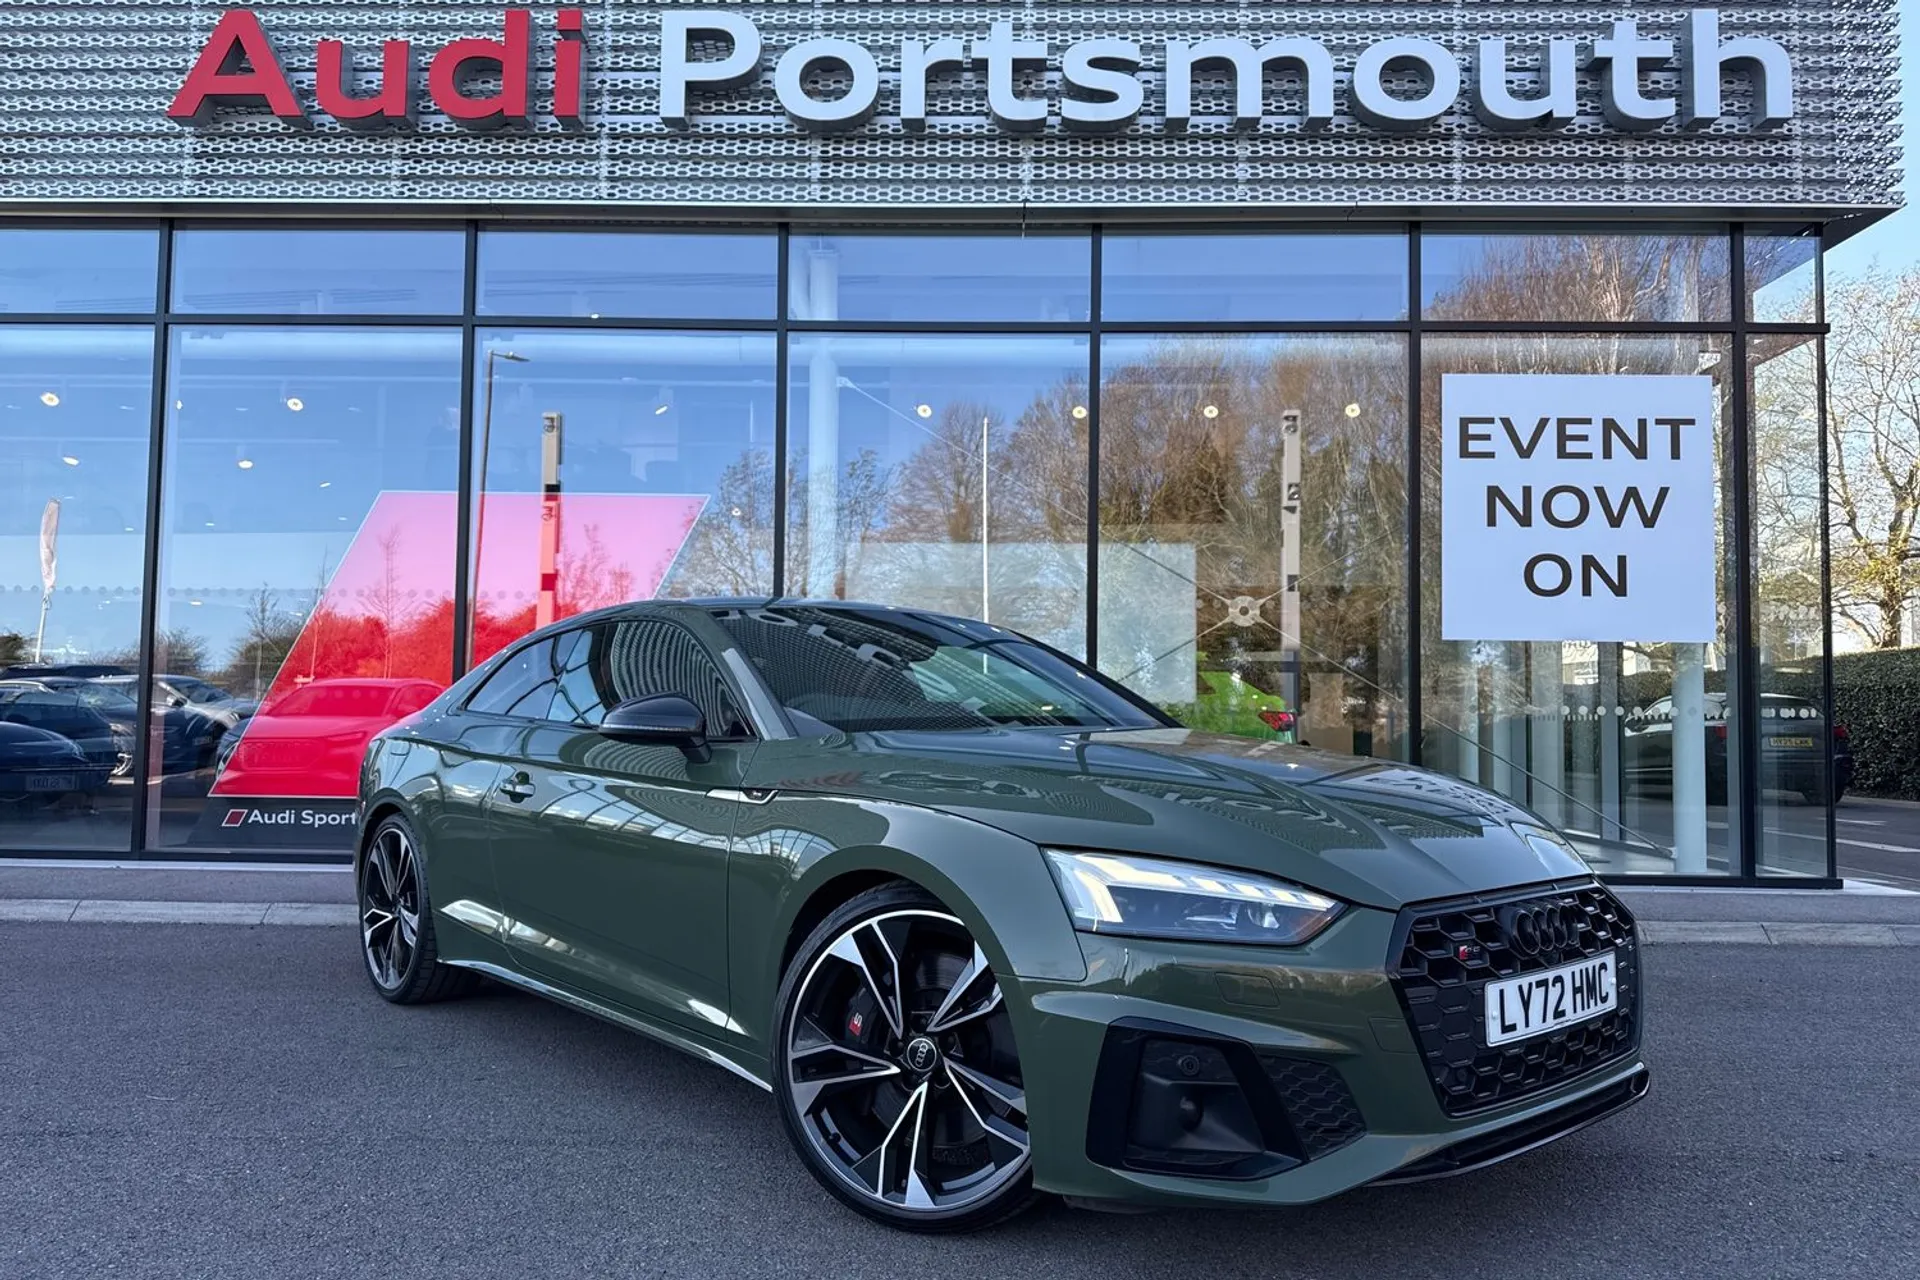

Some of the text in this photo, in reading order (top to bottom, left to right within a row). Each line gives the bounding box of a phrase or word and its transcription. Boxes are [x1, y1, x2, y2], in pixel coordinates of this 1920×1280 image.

[167, 8, 1794, 122] Audi Portsmouth
[1459, 417, 1697, 461] EVENT
[1486, 484, 1671, 529] NOW
[1523, 553, 1628, 598] ON
[247, 809, 357, 828] Audi Sport
[1498, 961, 1610, 1035] LY72 HMC
